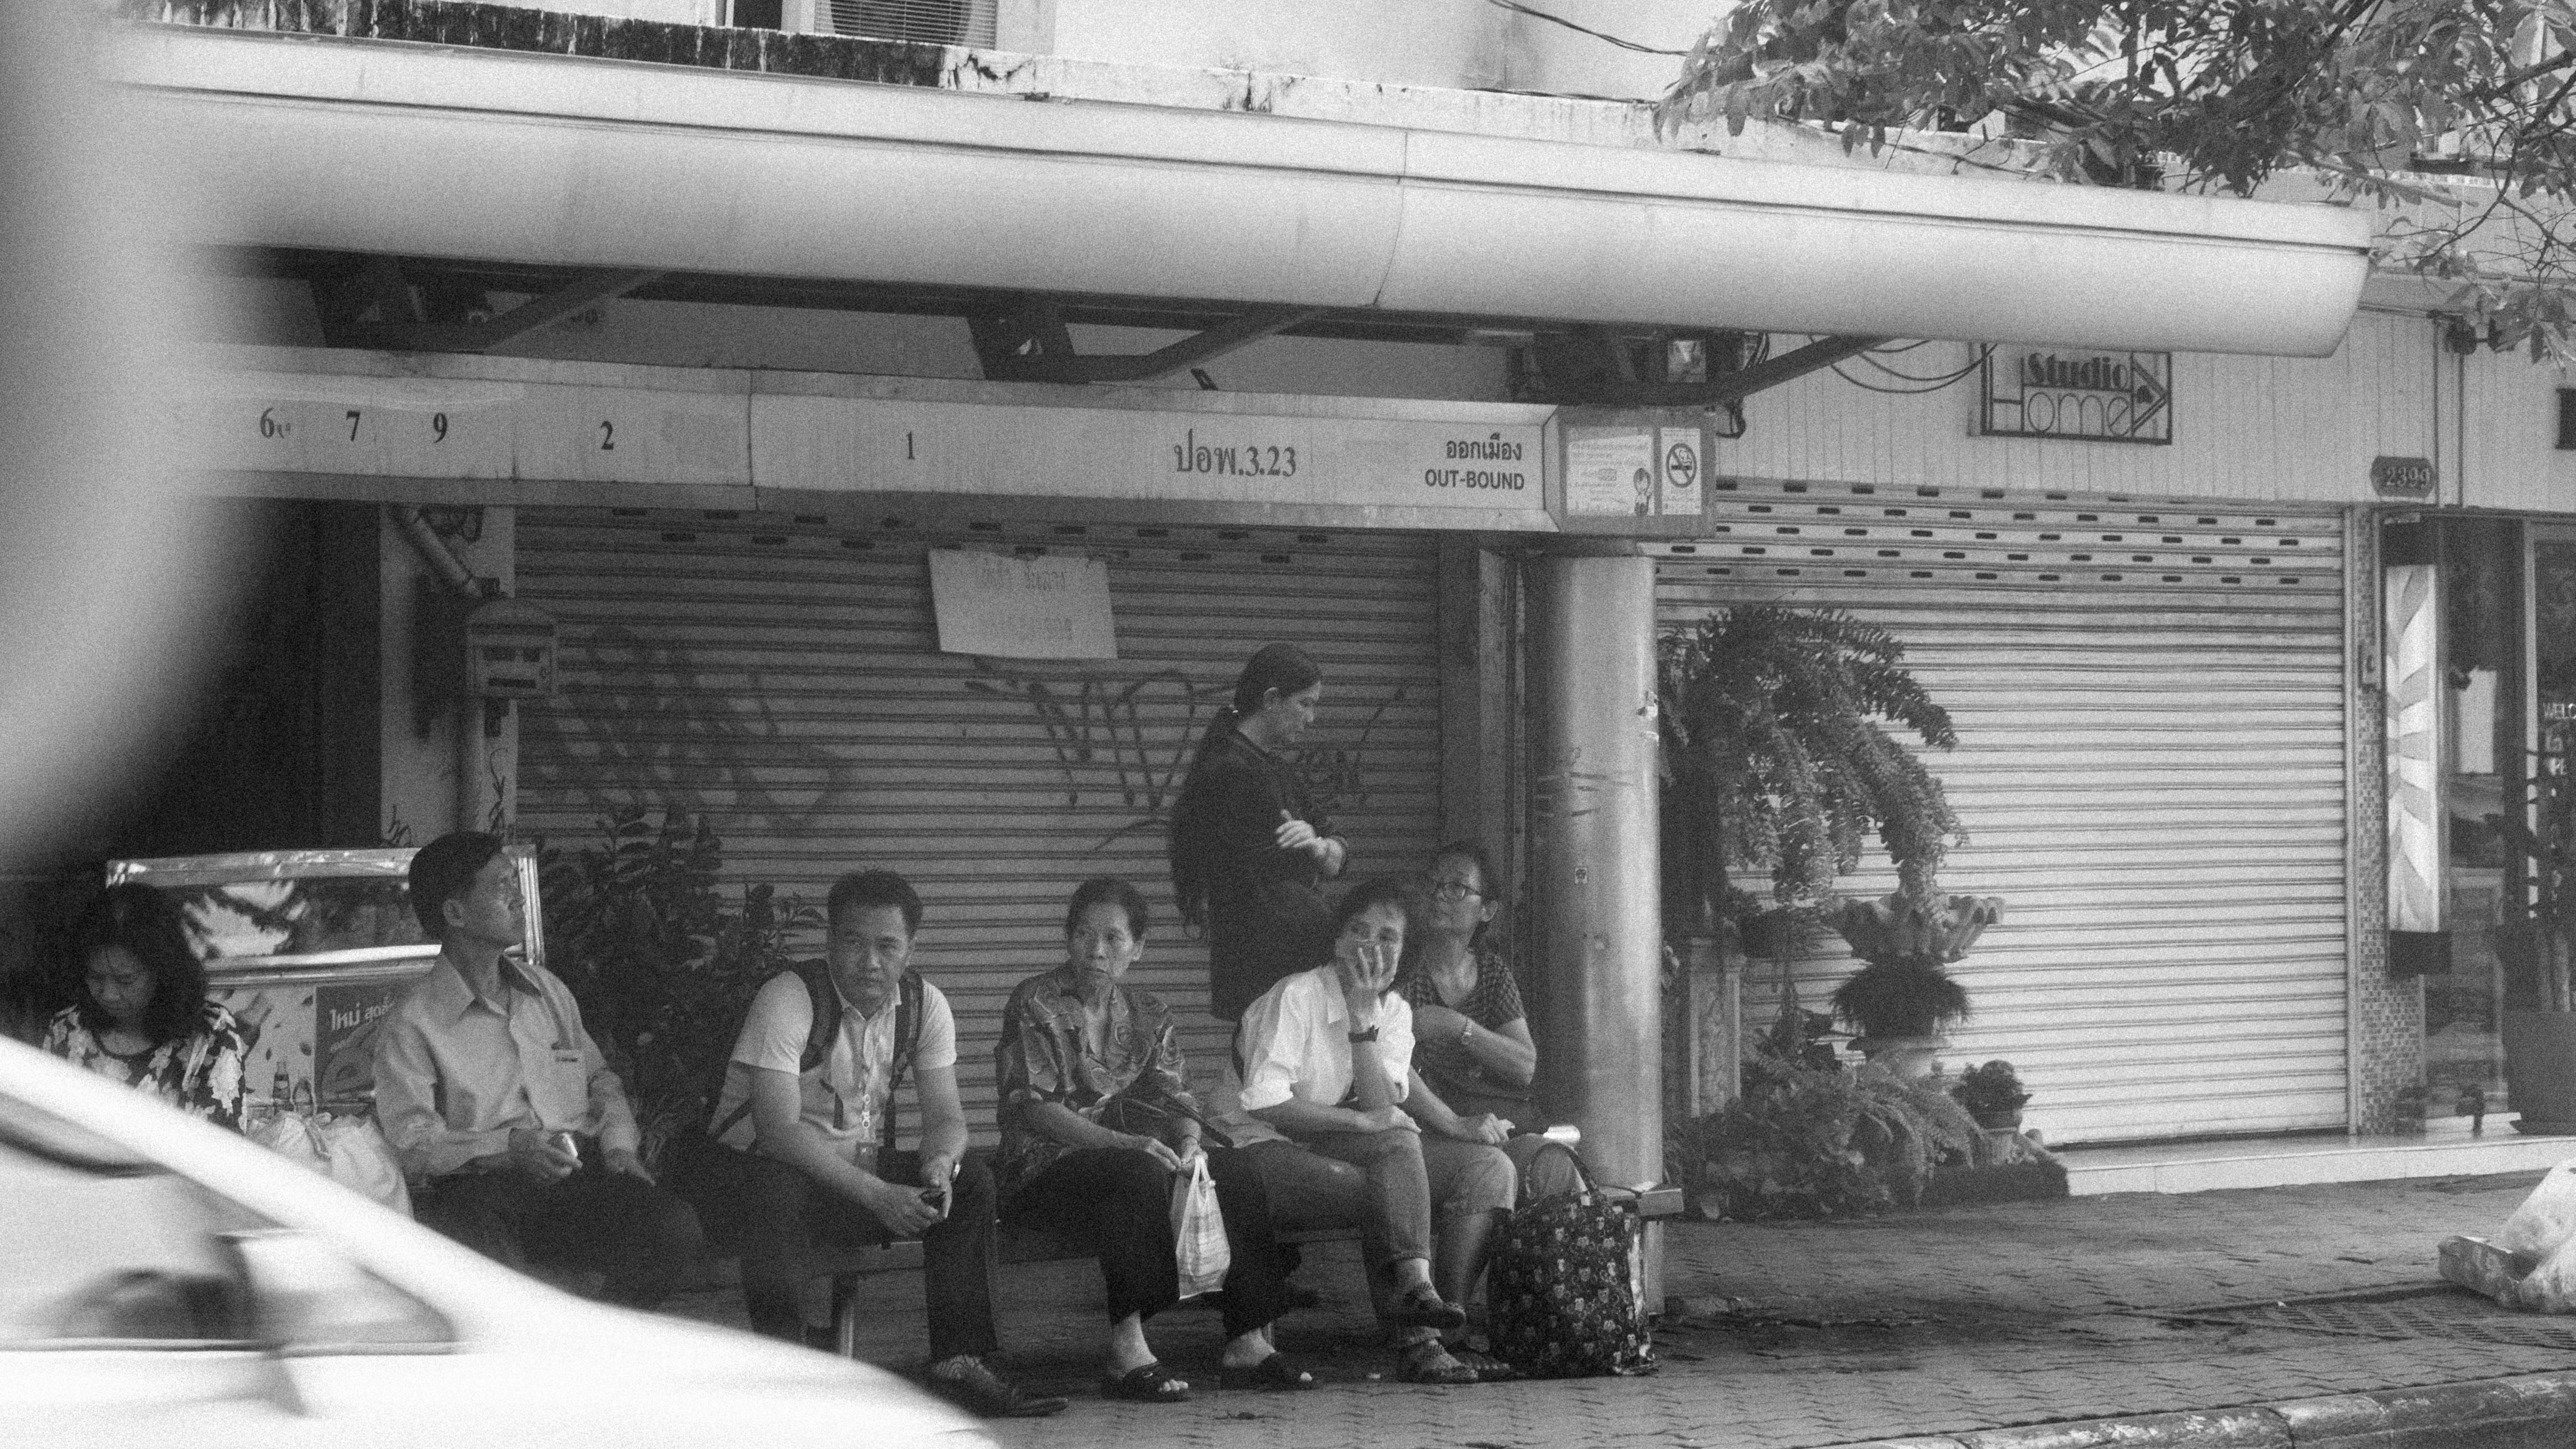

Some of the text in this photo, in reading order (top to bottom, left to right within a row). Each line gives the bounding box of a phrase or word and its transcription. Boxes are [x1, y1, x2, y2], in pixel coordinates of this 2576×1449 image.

[2027, 352, 2129, 390] Studio
[346, 411, 360, 441] 7
[433, 413, 448, 443] 9
[600, 421, 615, 450] 2
[907, 431, 916, 460] 1
[1446, 432, 1522, 461] ออกเมือง
[1174, 429, 1297, 477] ปอพ.3.23
[1424, 468, 1525, 490] OUT-BOUND
